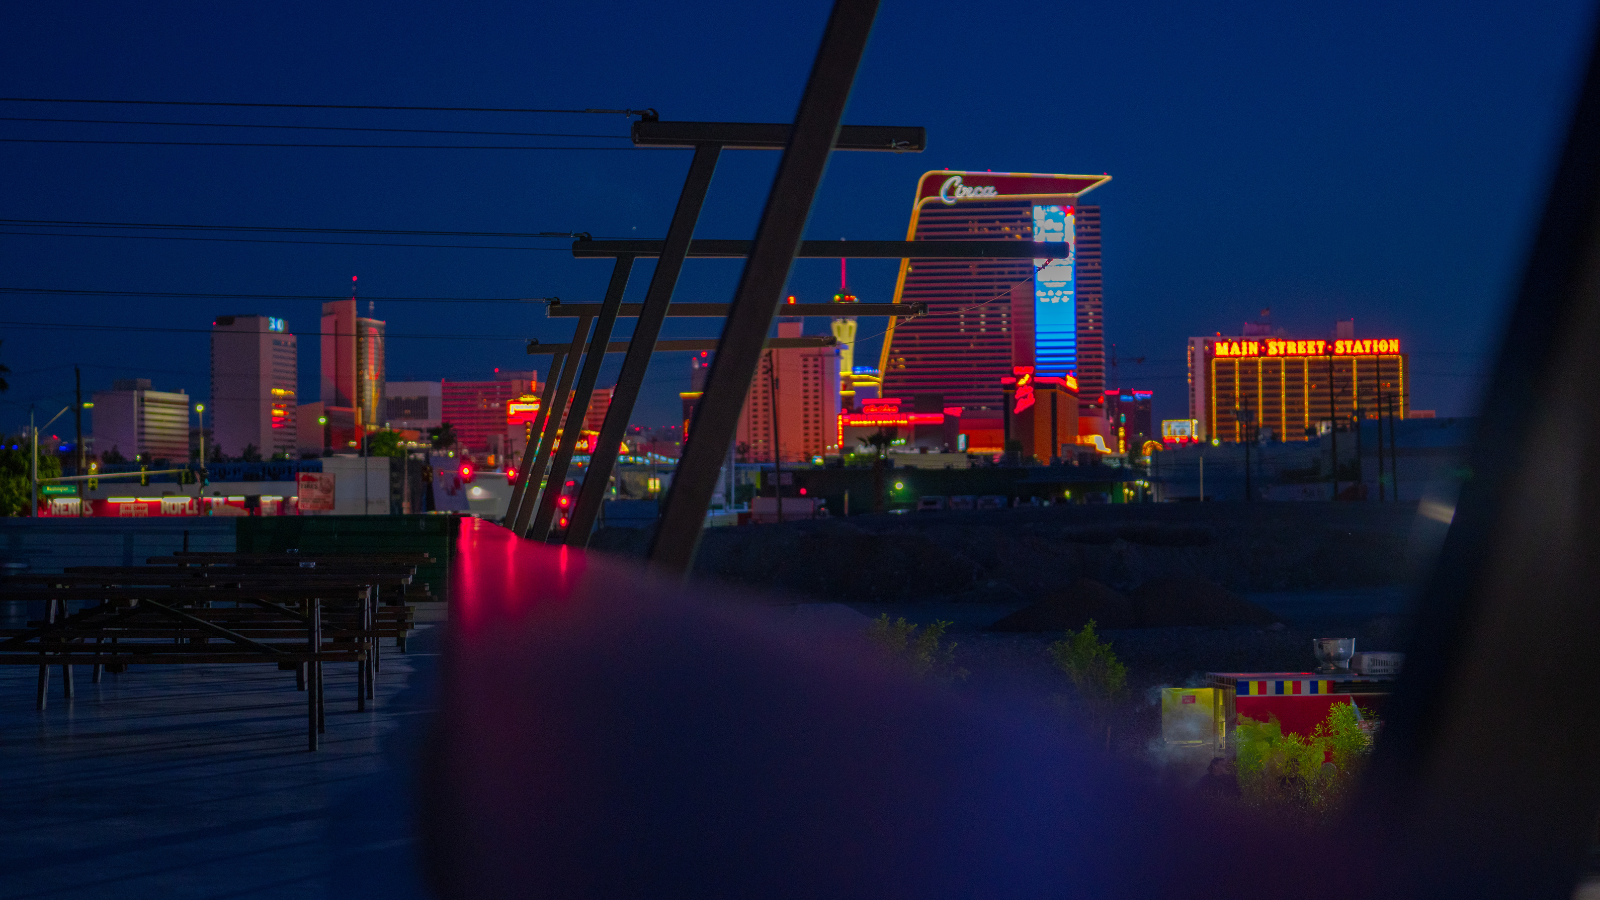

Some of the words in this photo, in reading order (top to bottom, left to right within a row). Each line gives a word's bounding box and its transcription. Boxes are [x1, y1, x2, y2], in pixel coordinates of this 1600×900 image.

[939, 175, 998, 205] Circa
[1215, 341, 1259, 356] MAIN
[1267, 340, 1326, 355] STREET
[1334, 339, 1399, 354] STATION
